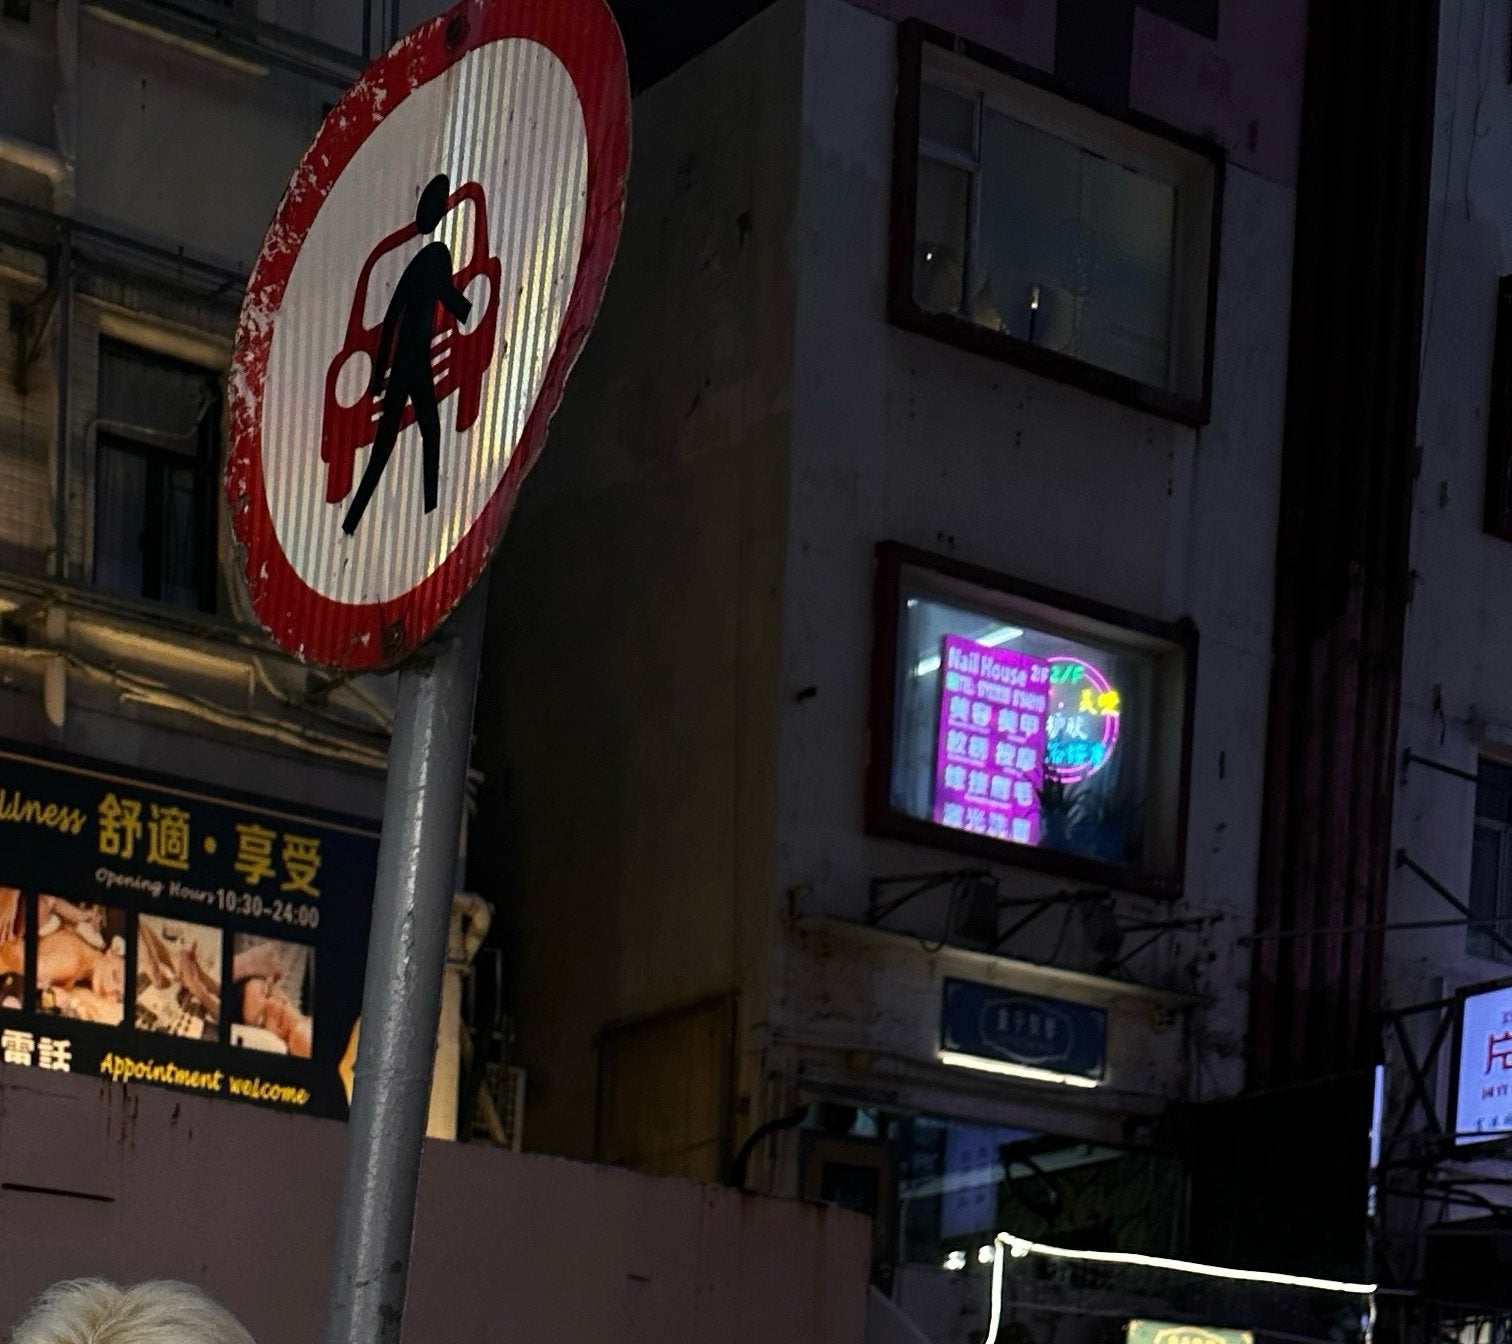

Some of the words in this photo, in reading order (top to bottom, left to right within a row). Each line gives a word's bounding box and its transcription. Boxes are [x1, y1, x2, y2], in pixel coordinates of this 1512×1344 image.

[948, 646, 980, 675] Nail
[981, 655, 1028, 687] House
[94, 867, 165, 897] Opening
[216, 887, 320, 929] 10:30-24:00
[100, 1051, 224, 1091] Appointment
[229, 1075, 311, 1106] welcome
